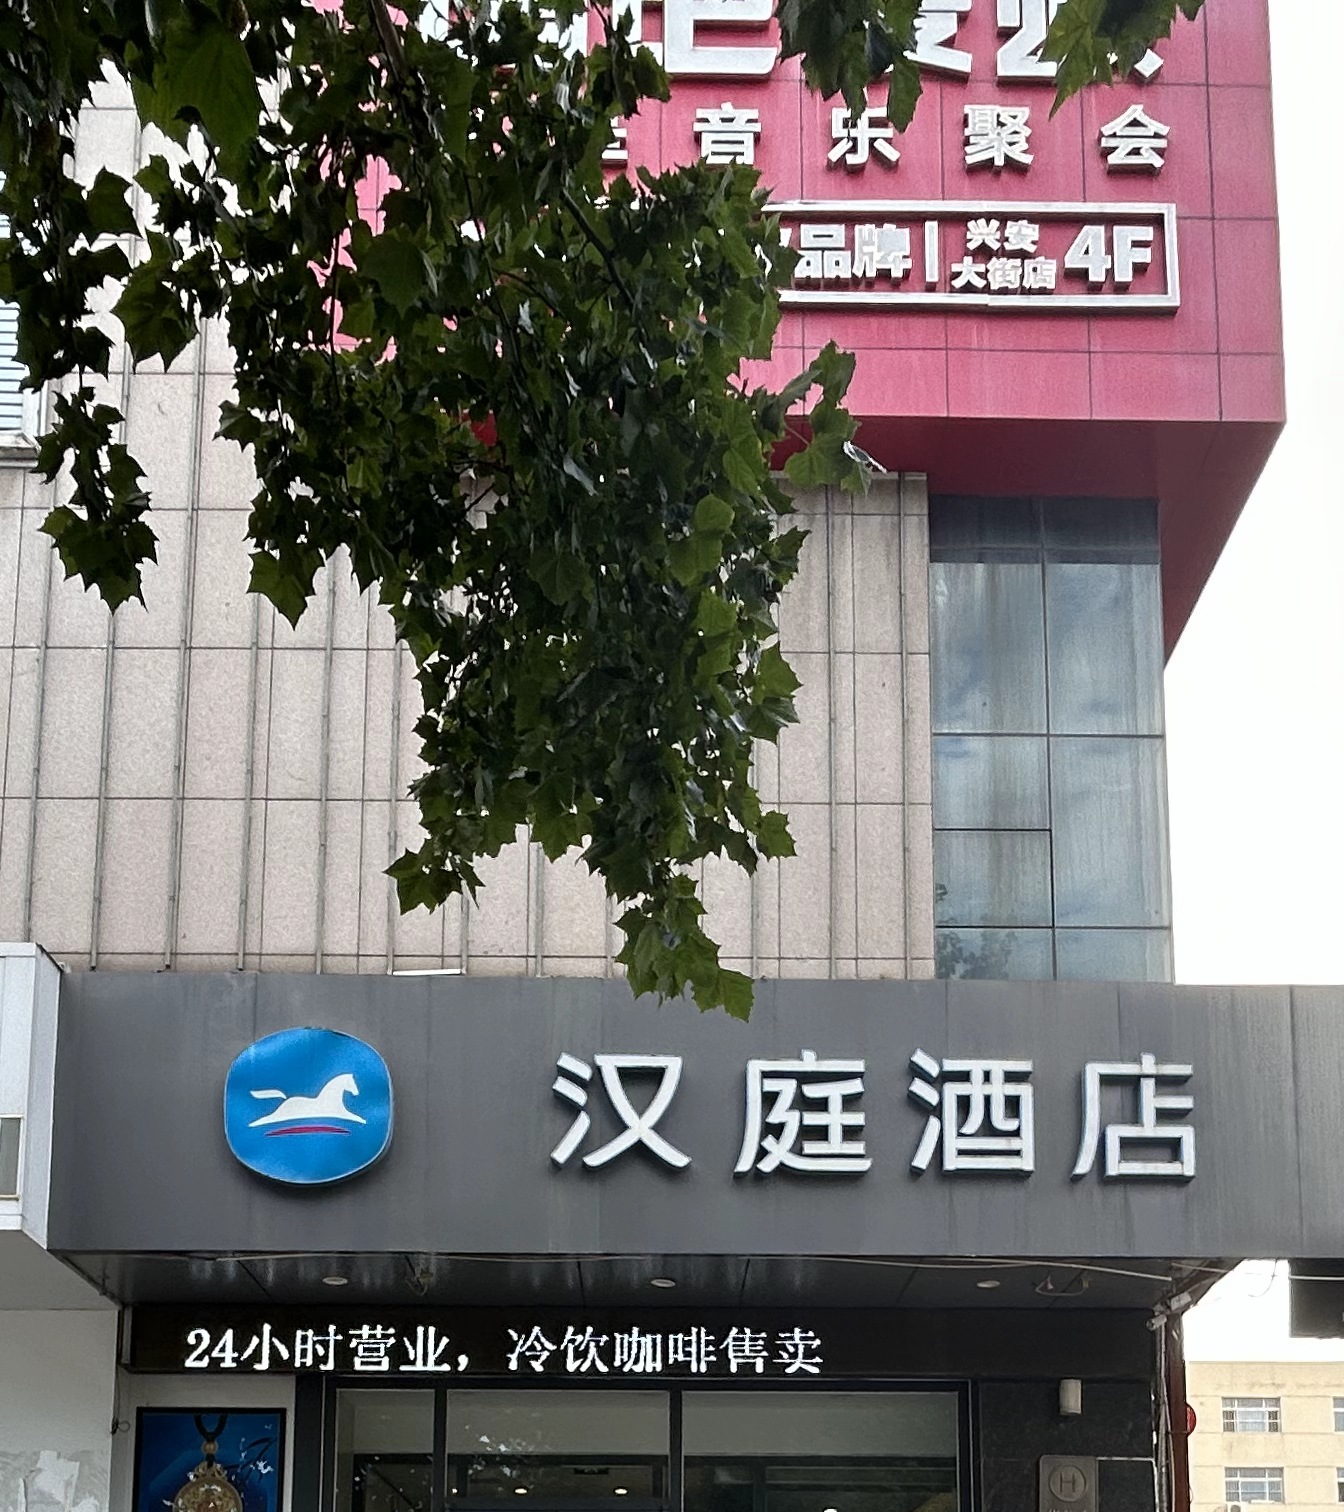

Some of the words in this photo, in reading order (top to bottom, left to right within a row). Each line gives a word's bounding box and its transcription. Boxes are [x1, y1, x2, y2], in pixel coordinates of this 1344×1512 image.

[965, 217, 1041, 252] 兴安
[1064, 224, 1155, 283] 4F
[950, 255, 1057, 291] 大街店
[550, 1048, 1197, 1182] 汉庭酒店
